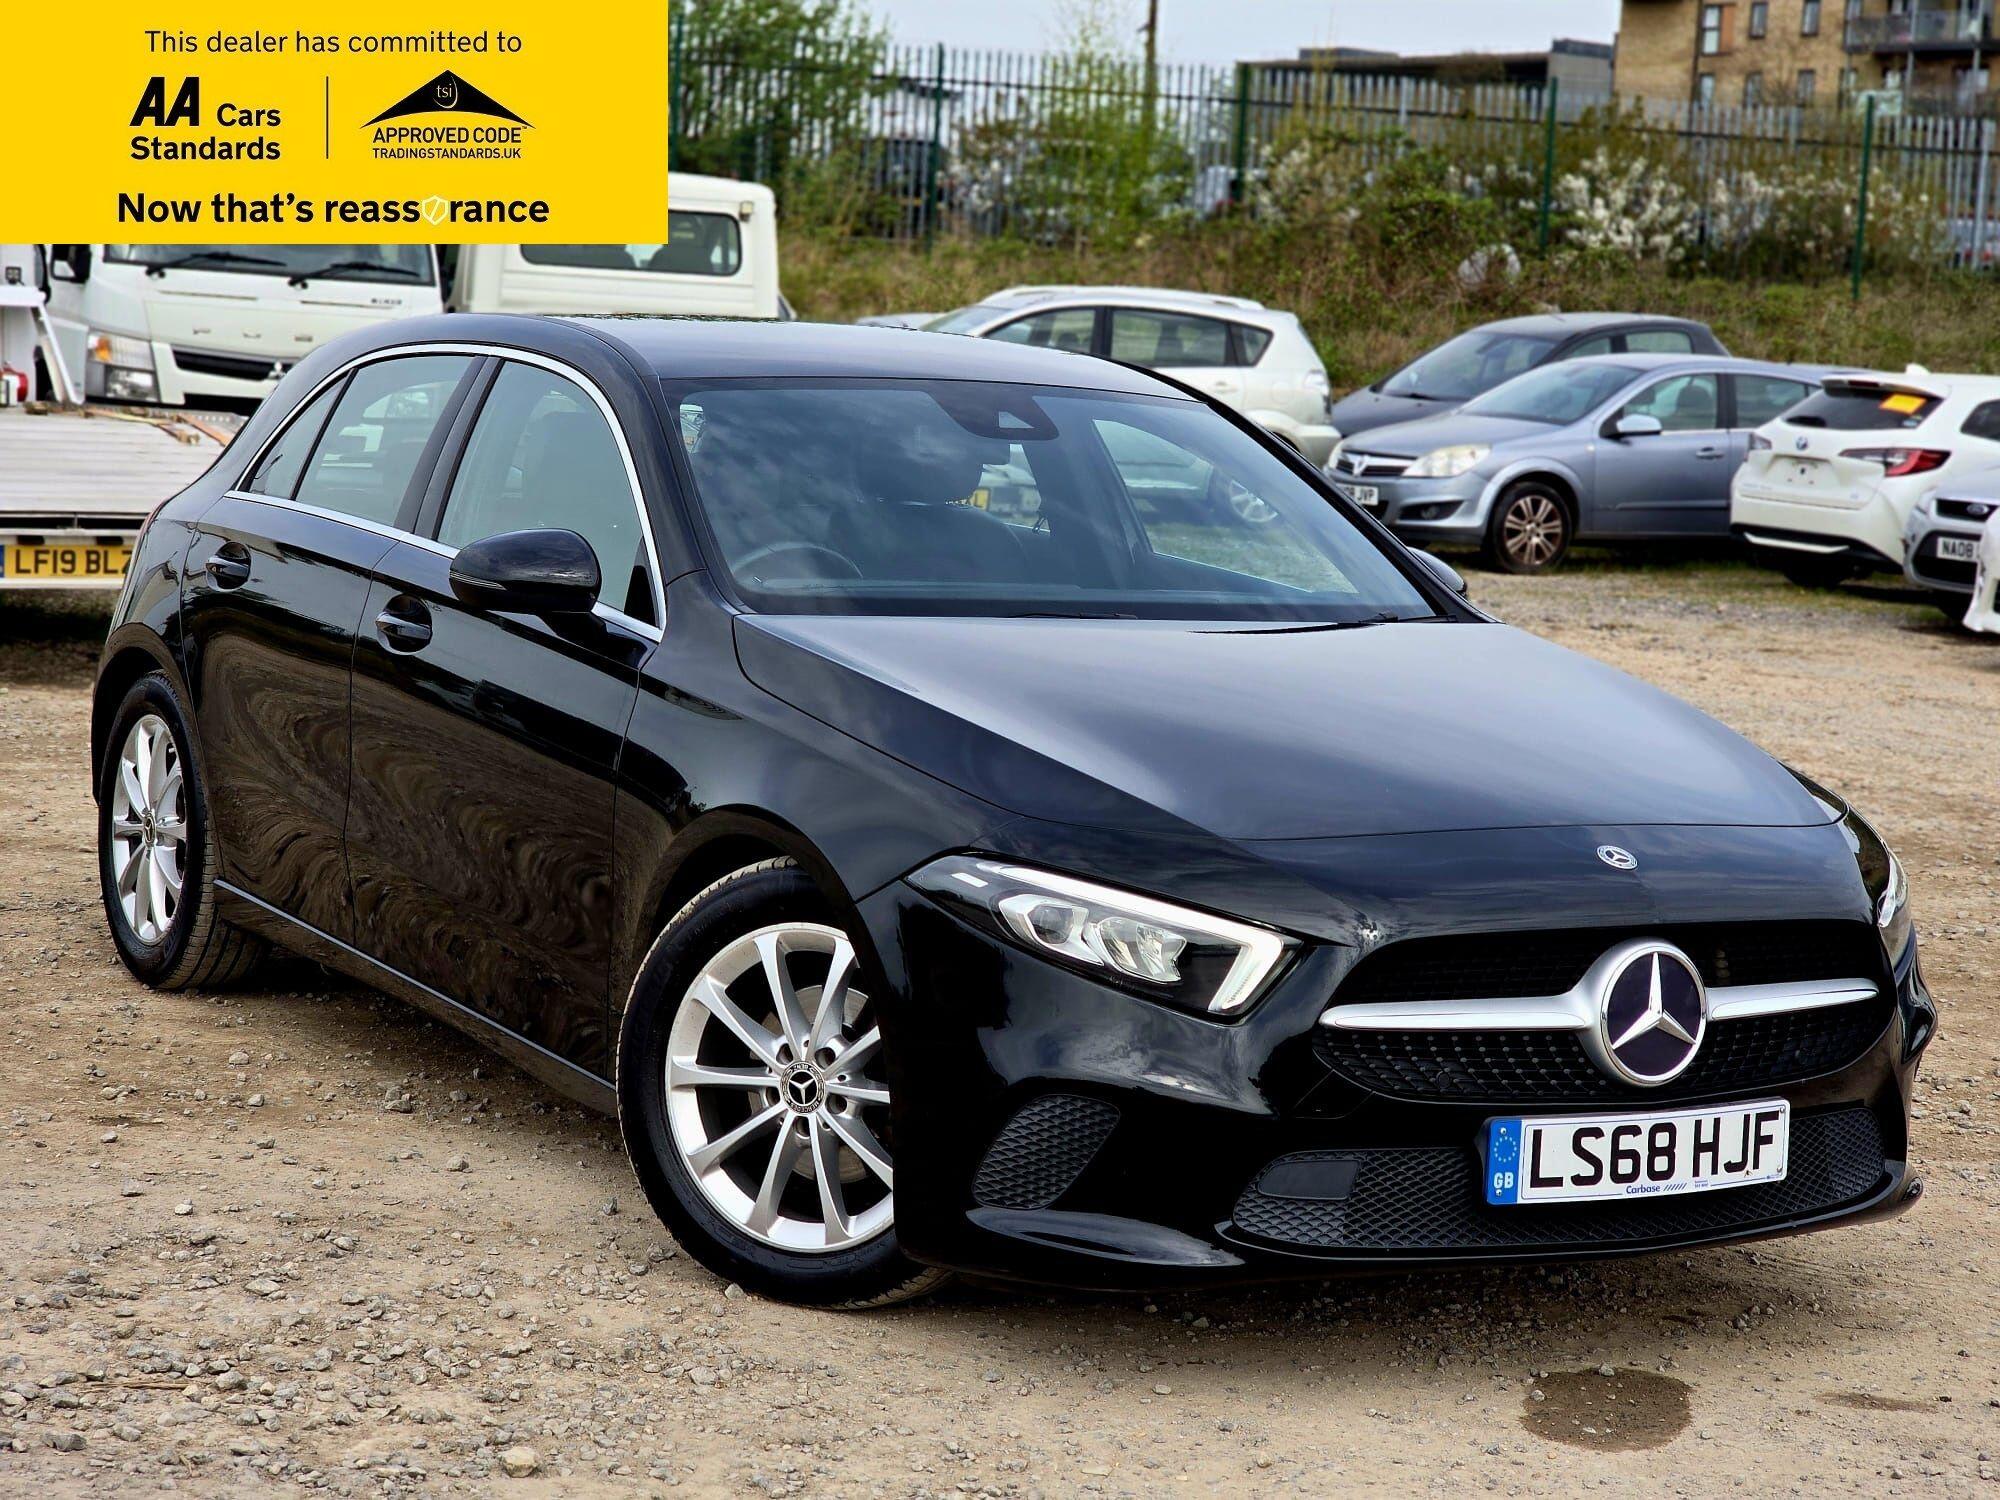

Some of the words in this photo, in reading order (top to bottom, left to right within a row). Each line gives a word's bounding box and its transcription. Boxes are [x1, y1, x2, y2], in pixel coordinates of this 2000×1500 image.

[15, 549, 76, 574] LF19
[1529, 1122, 1677, 1188] LS68
[1692, 1110, 1780, 1177] HJF
[1493, 1171, 1514, 1189] GB
[1626, 1184, 1661, 1195] Carbase
